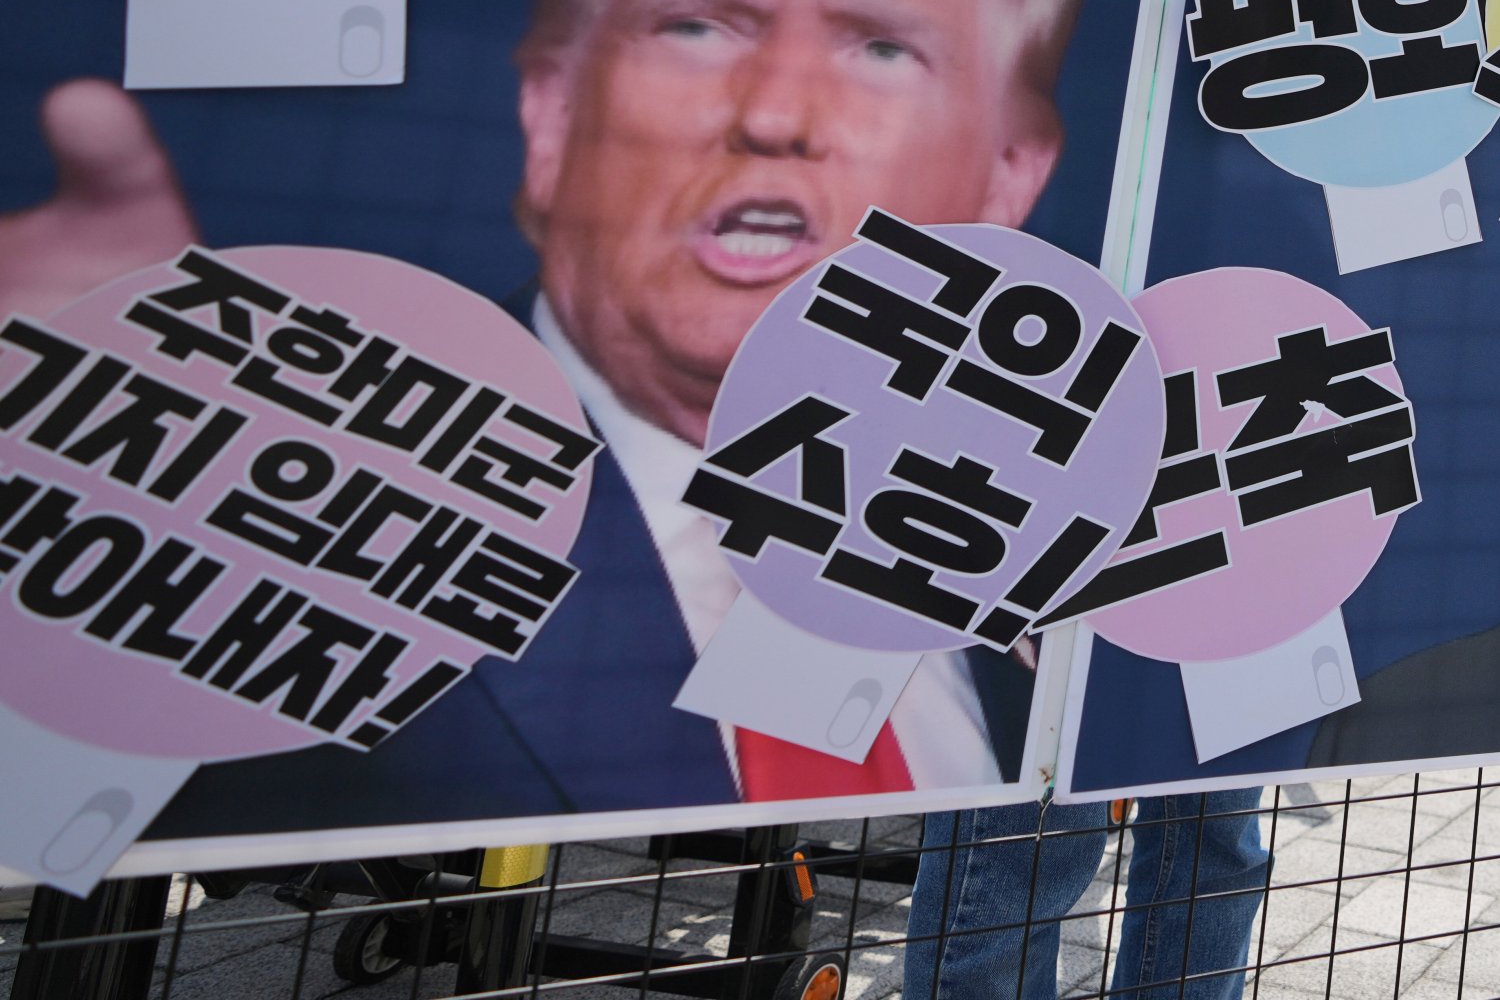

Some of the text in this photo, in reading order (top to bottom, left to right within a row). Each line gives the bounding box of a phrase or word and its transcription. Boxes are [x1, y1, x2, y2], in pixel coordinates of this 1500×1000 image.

[125, 250, 601, 521] 주한미군
[803, 210, 1142, 468] 국익
[0, 320, 580, 661] 기지 임대료
[681, 395, 1113, 651] 수호!
